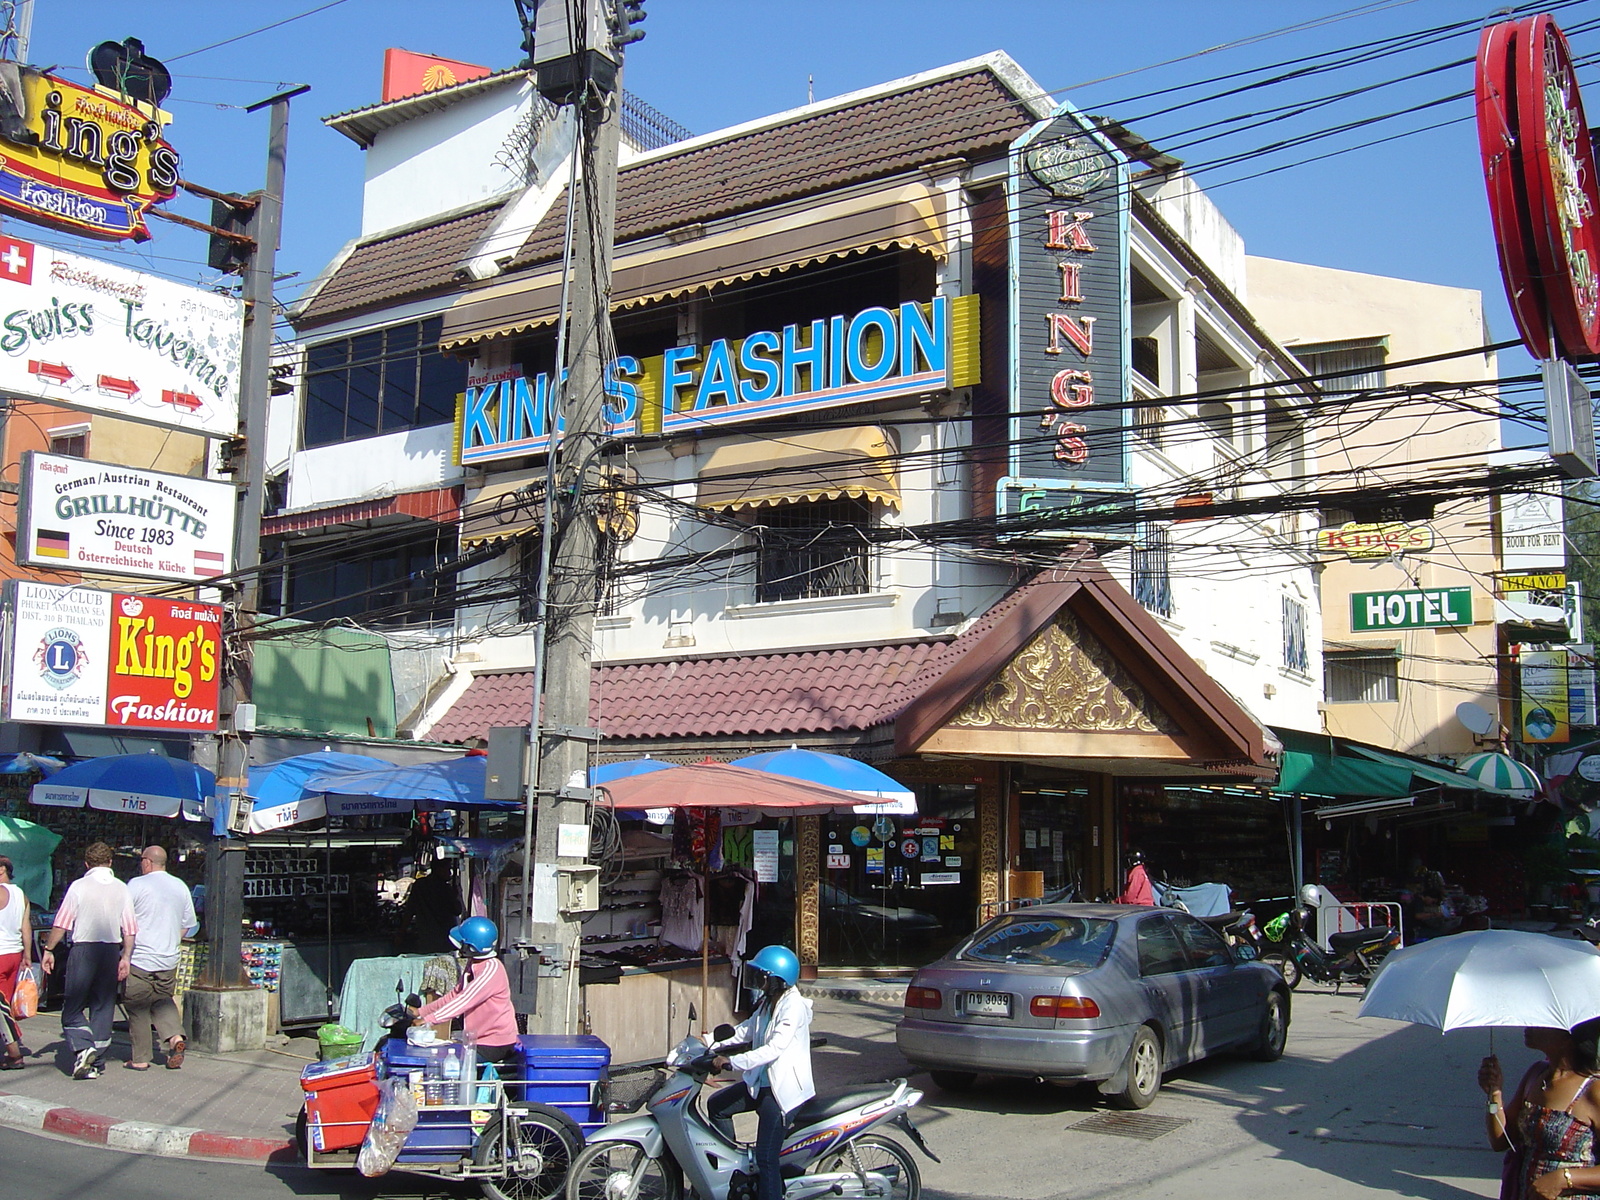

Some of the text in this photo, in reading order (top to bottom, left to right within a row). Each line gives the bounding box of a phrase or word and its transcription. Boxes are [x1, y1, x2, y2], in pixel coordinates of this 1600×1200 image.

[39, 90, 180, 190] ing's
[1, 297, 230, 400] Swiss Taverne
[663, 296, 948, 413] FASHION
[156, 480, 208, 517] Restaurant
[55, 494, 208, 540] GRILLHÜTTE
[95, 519, 175, 546] Since 1983
[1506, 533, 1561, 548] ROOM FOR RENT
[114, 541, 153, 555] Deutsch
[78, 547, 186, 574] Österreichische Küche
[1507, 575, 1562, 590] VACANCY
[26, 586, 103, 606] LIONS CLUB
[21, 599, 106, 617] PHUKET ANDAMAN SEA
[171, 605, 194, 620] คิงส์
[1366, 591, 1458, 626] HOTEL
[22, 611, 104, 627] DIST. 310 B THAILAND
[48, 629, 78, 643] LIONS
[53, 645, 70, 670] L
[115, 616, 216, 699] King's
[112, 695, 214, 724] Fashion
[121, 795, 147, 811] TMB
[341, 800, 398, 810] ธนาคารทหารไทย
[276, 806, 299, 824] TMB
[985, 994, 1009, 1006] 3039
